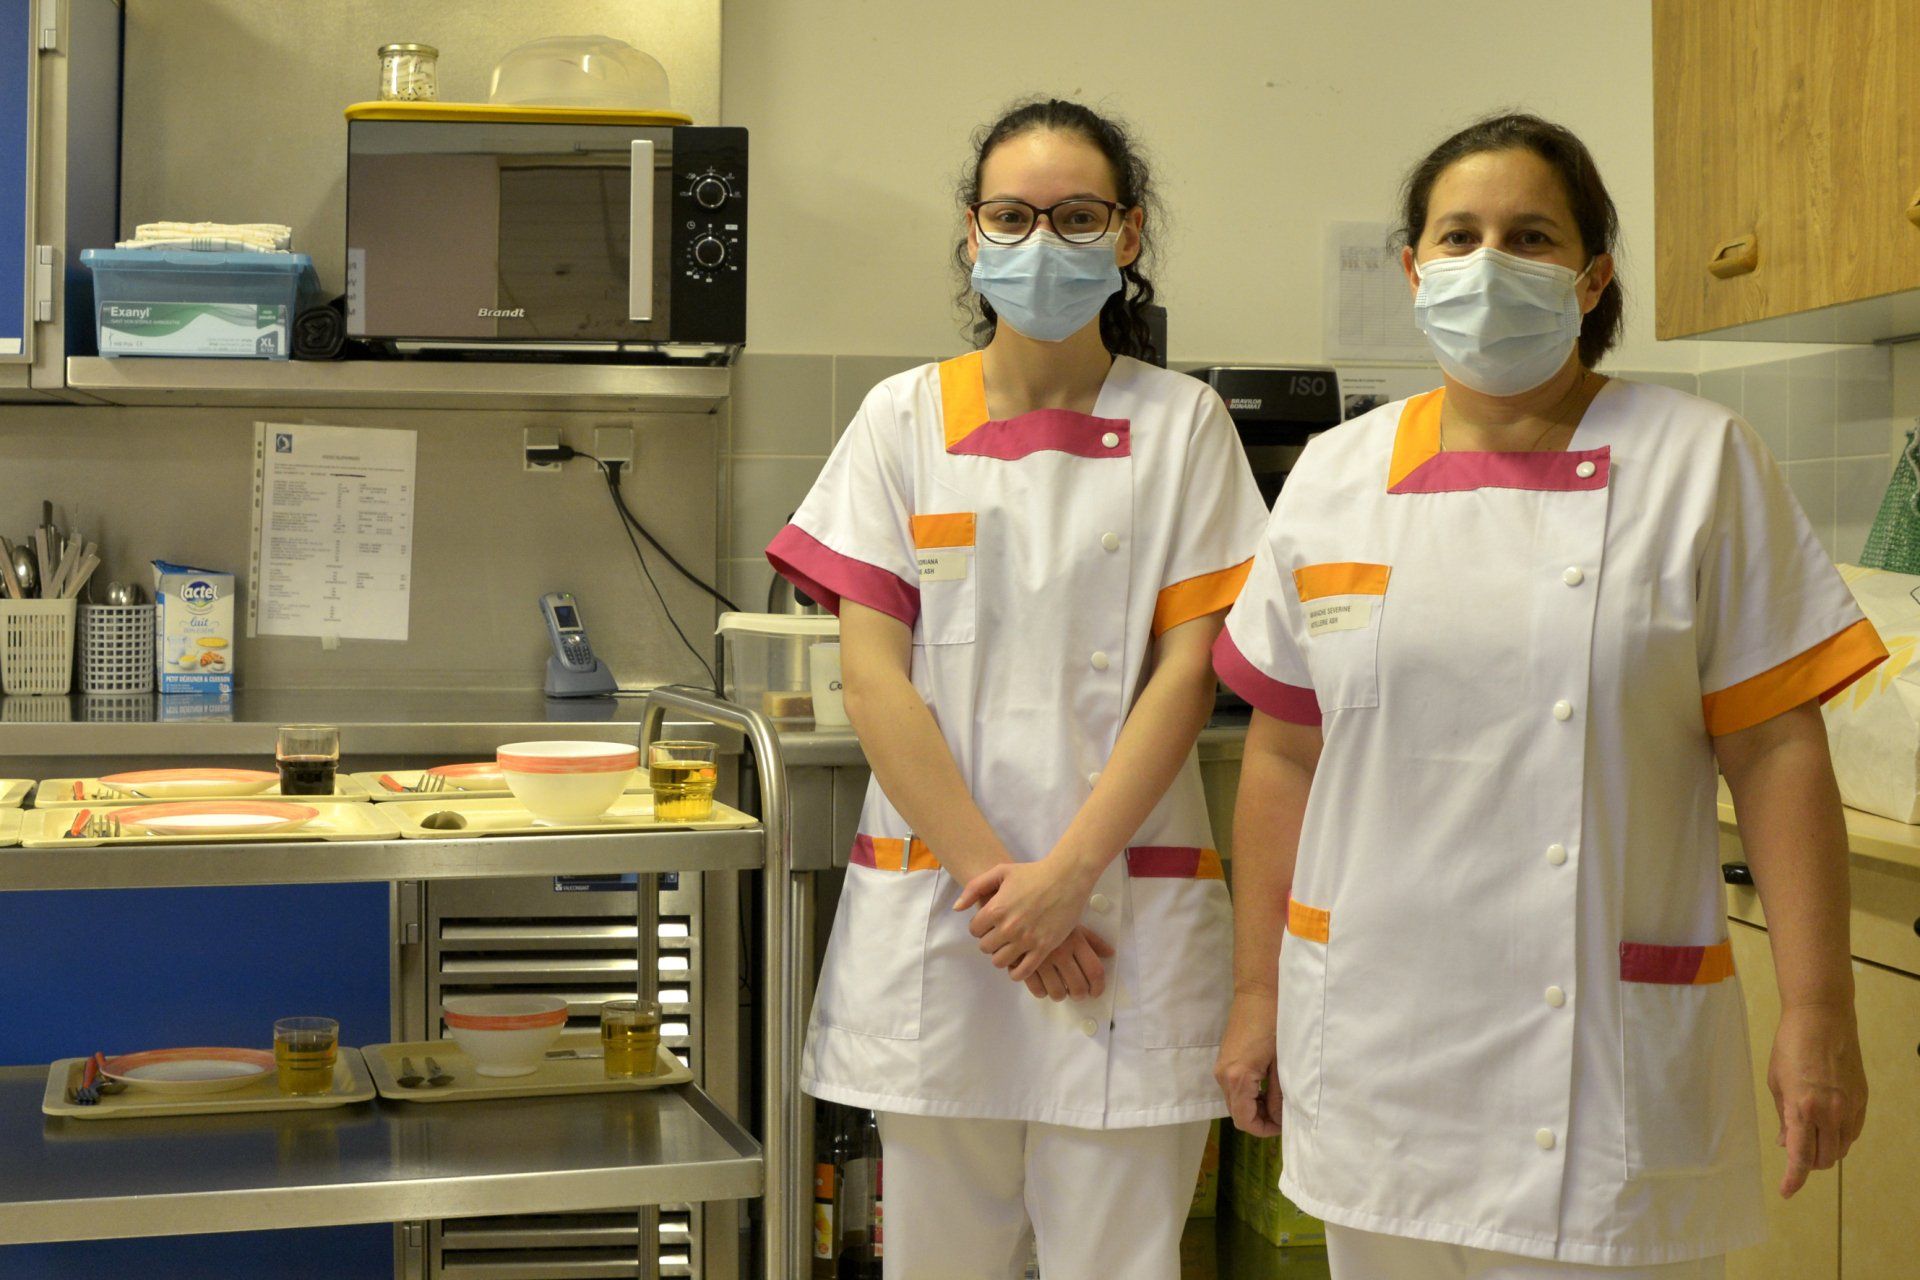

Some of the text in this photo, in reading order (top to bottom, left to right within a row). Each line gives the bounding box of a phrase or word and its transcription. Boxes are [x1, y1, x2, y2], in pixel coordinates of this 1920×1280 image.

[111, 306, 150, 319] Exanyl
[478, 308, 526, 318] Brandt
[261, 337, 275, 348] XL
[1289, 376, 1327, 396] ISO
[181, 584, 218, 602] lactel
